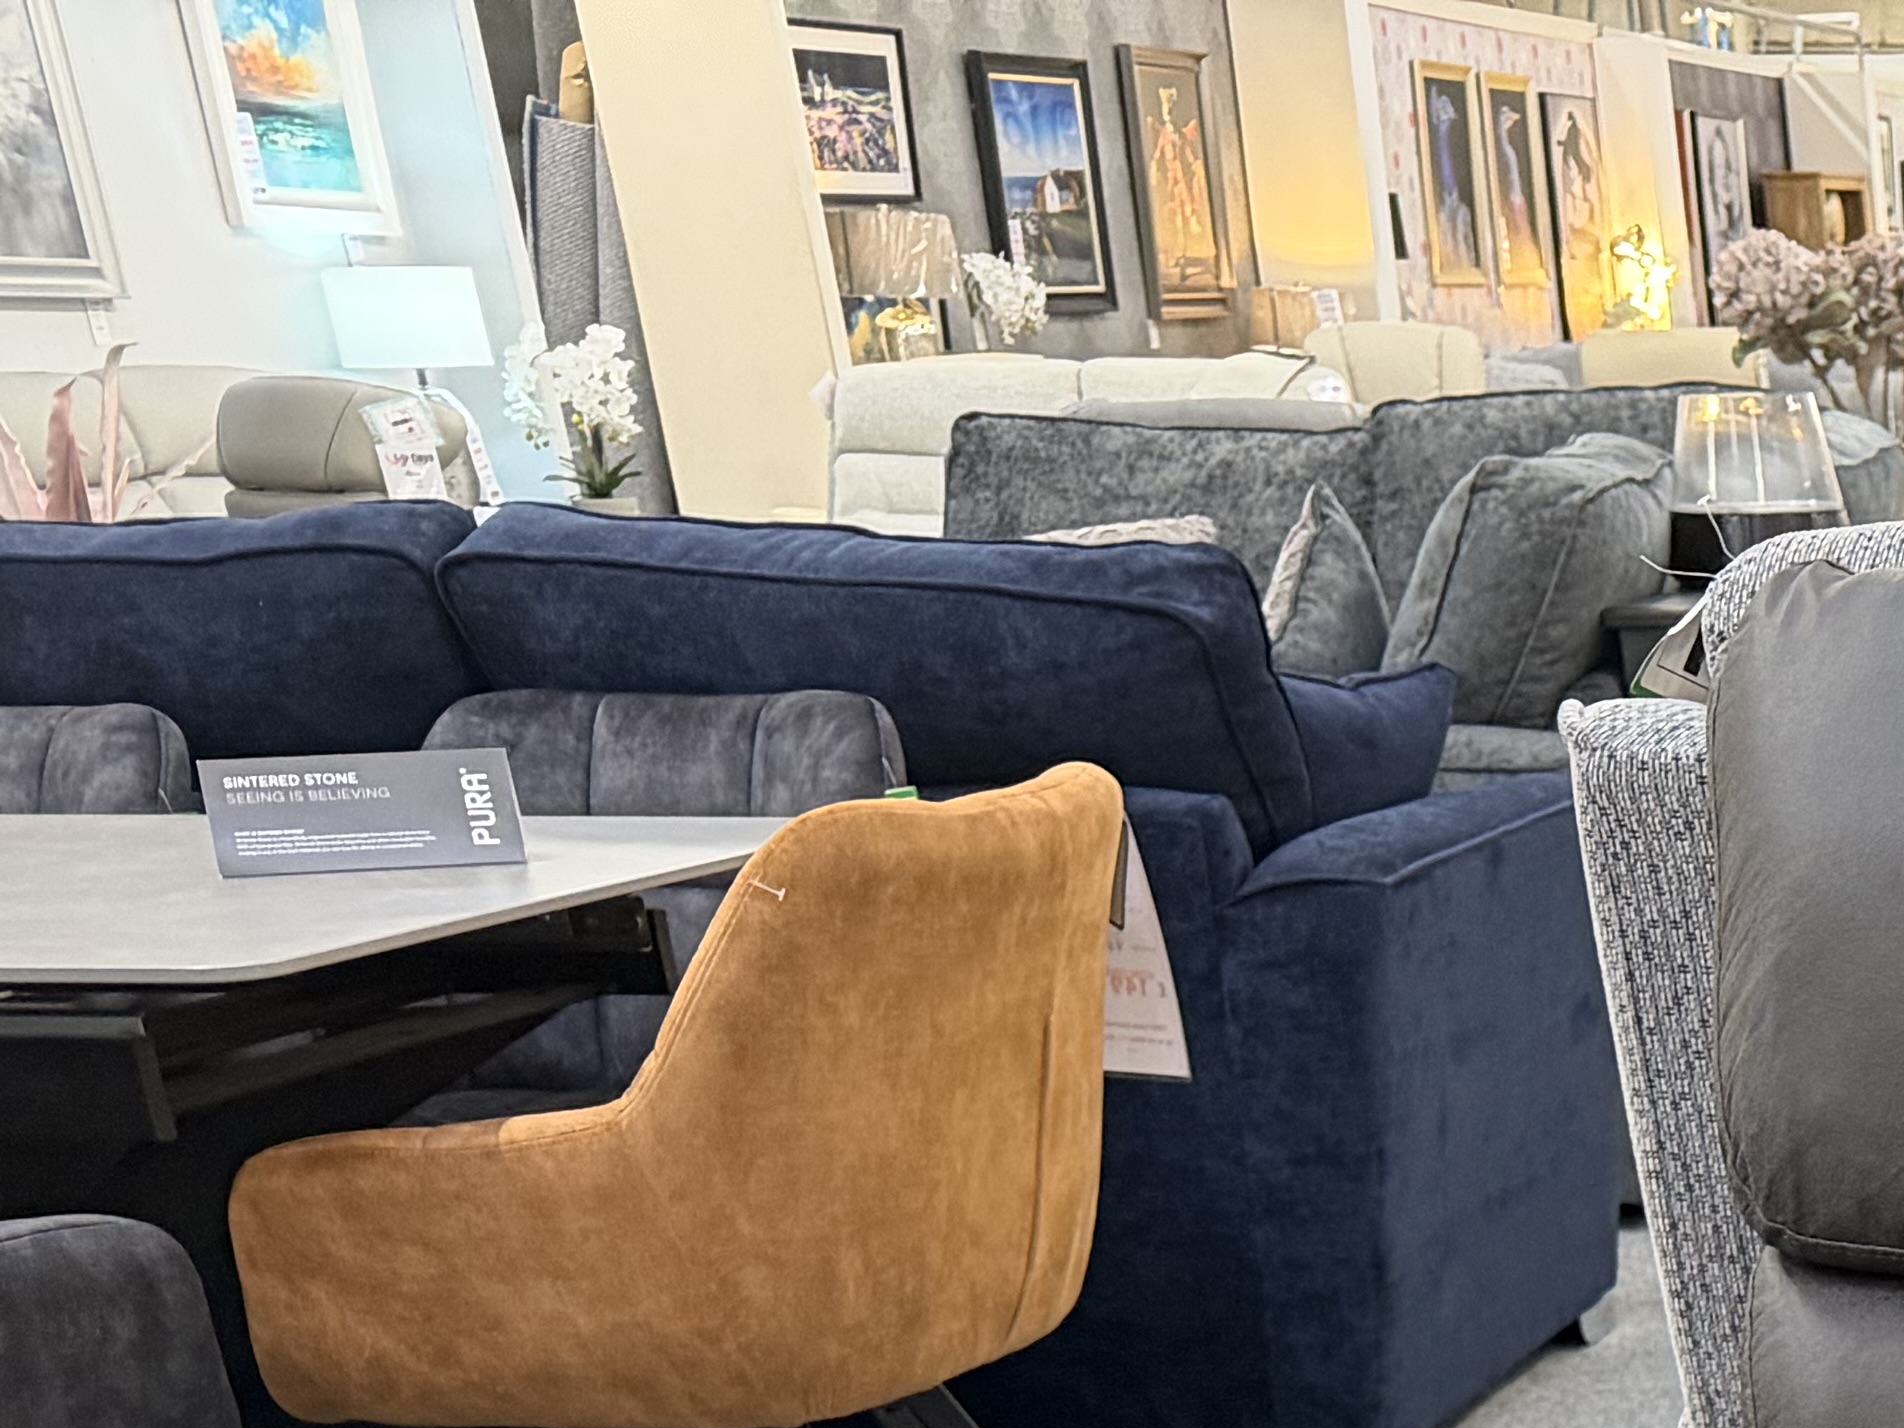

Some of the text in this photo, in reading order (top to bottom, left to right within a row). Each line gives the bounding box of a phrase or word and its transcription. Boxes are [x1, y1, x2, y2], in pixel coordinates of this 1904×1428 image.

[222, 772, 358, 789] SINTERED STONE
[226, 787, 391, 805] SEEING IS BELIEVING
[460, 772, 501, 846] PURA
